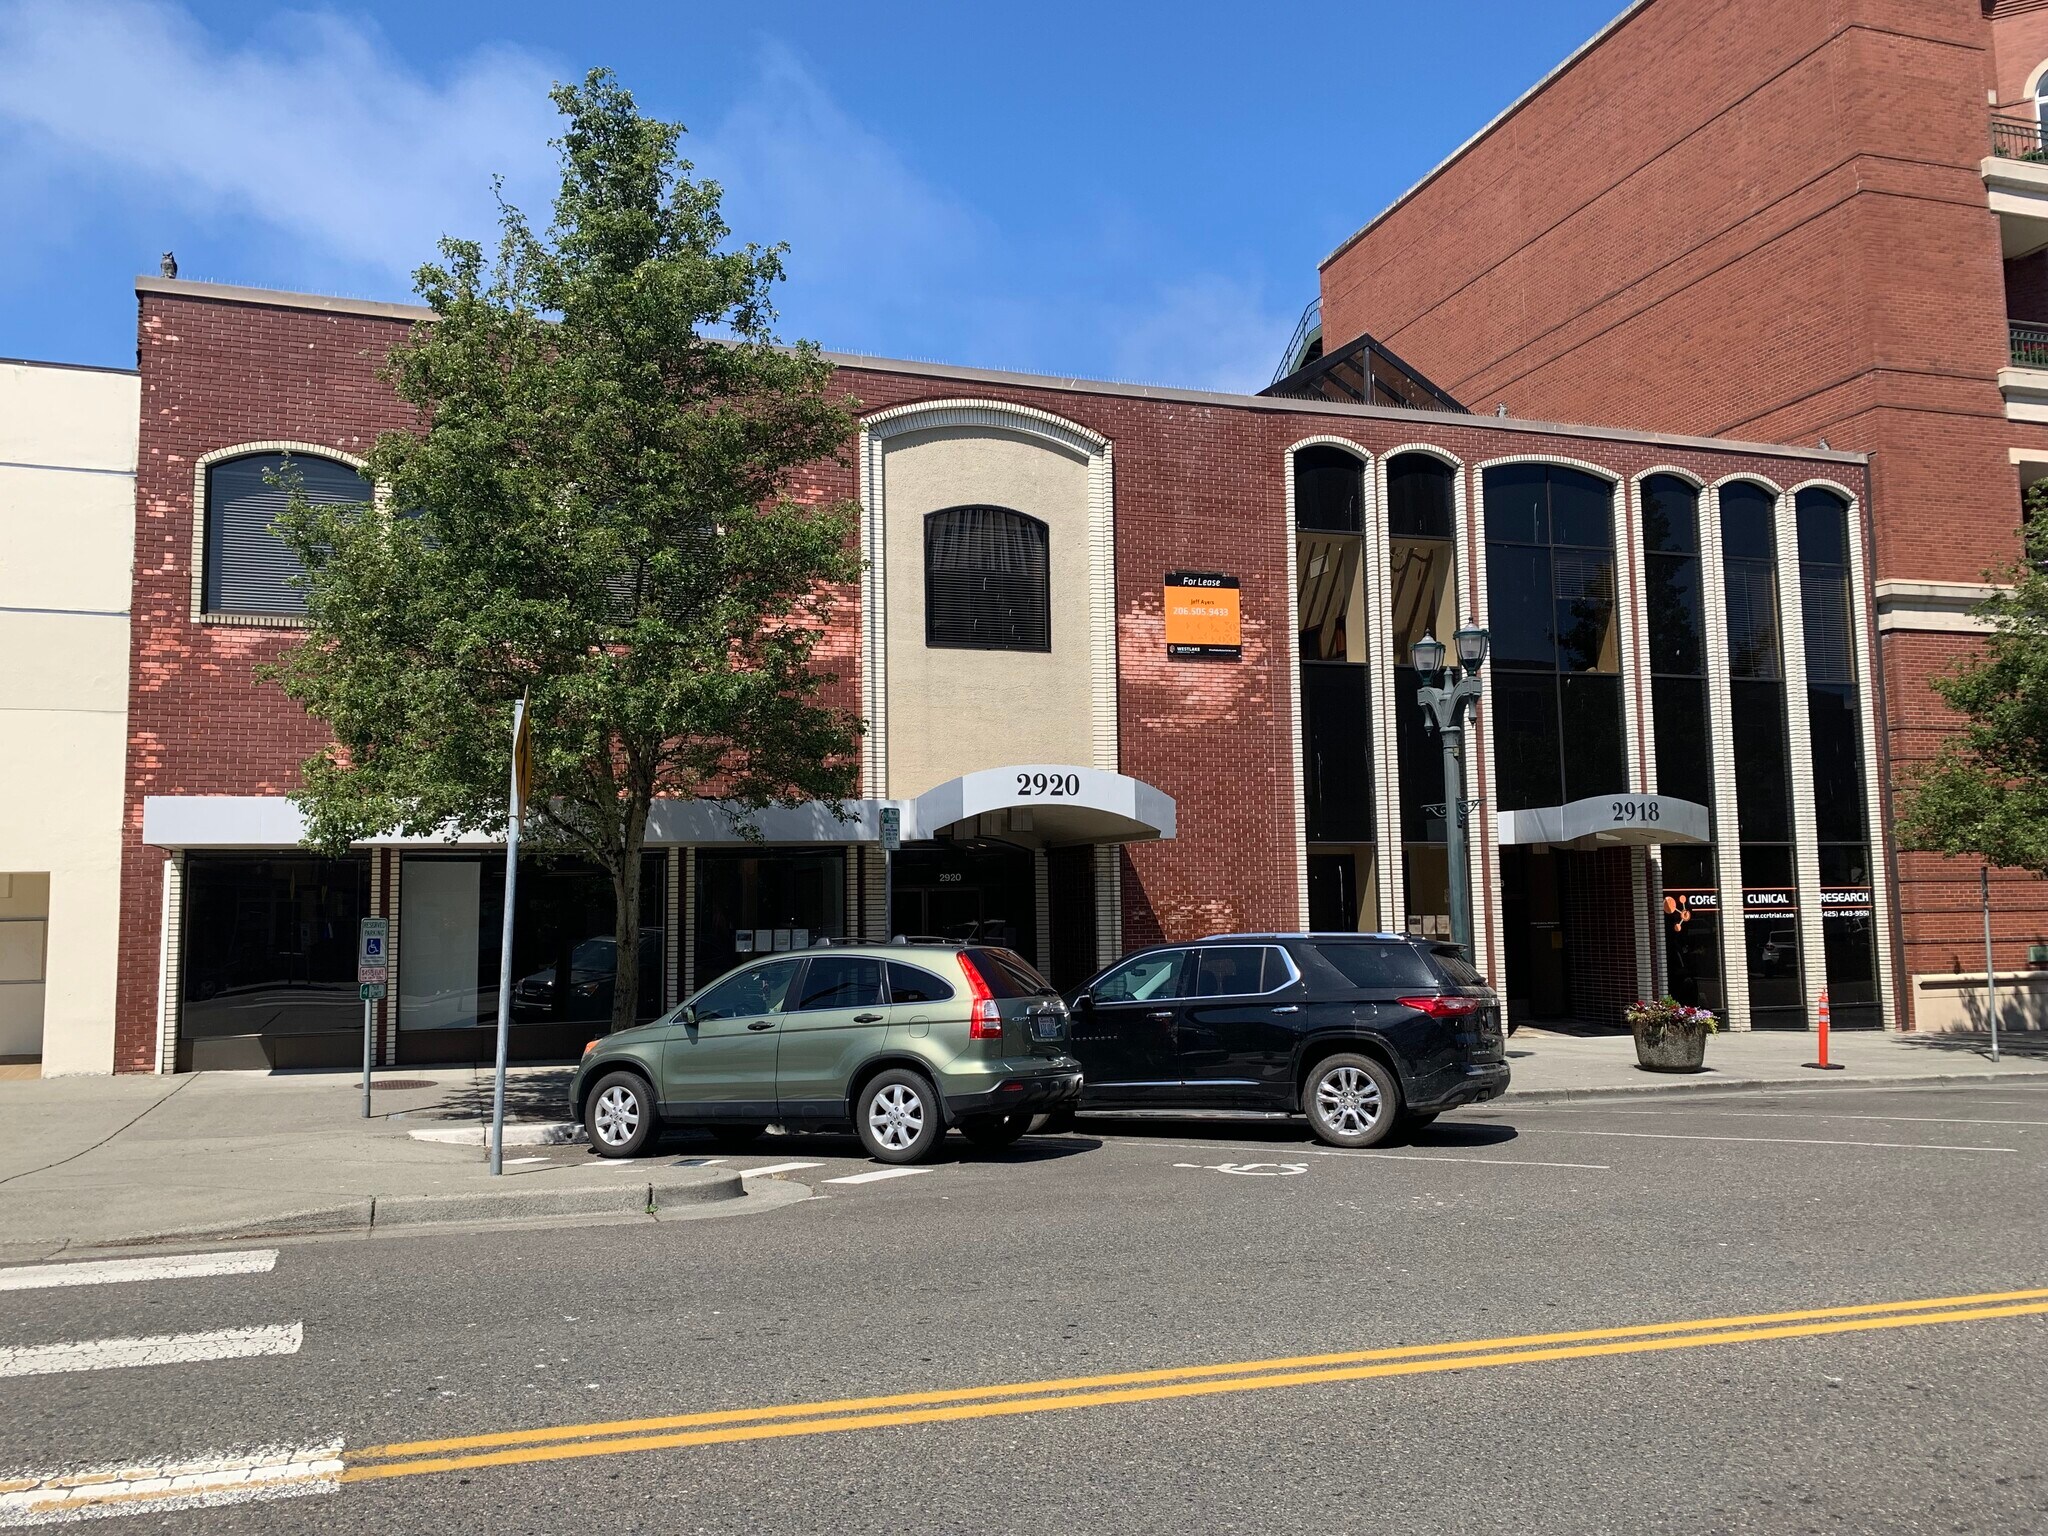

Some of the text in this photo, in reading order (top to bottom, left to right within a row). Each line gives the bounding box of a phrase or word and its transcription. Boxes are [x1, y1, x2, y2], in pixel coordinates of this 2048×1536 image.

[1183, 577, 1221, 587] For Lease
[1017, 773, 1080, 796] 2920
[1612, 801, 1660, 821] 2918
[940, 873, 962, 881] 2920
[1689, 892, 1869, 905] CORE CLINICAL RESEARCH
[362, 921, 386, 929] RESERVED
